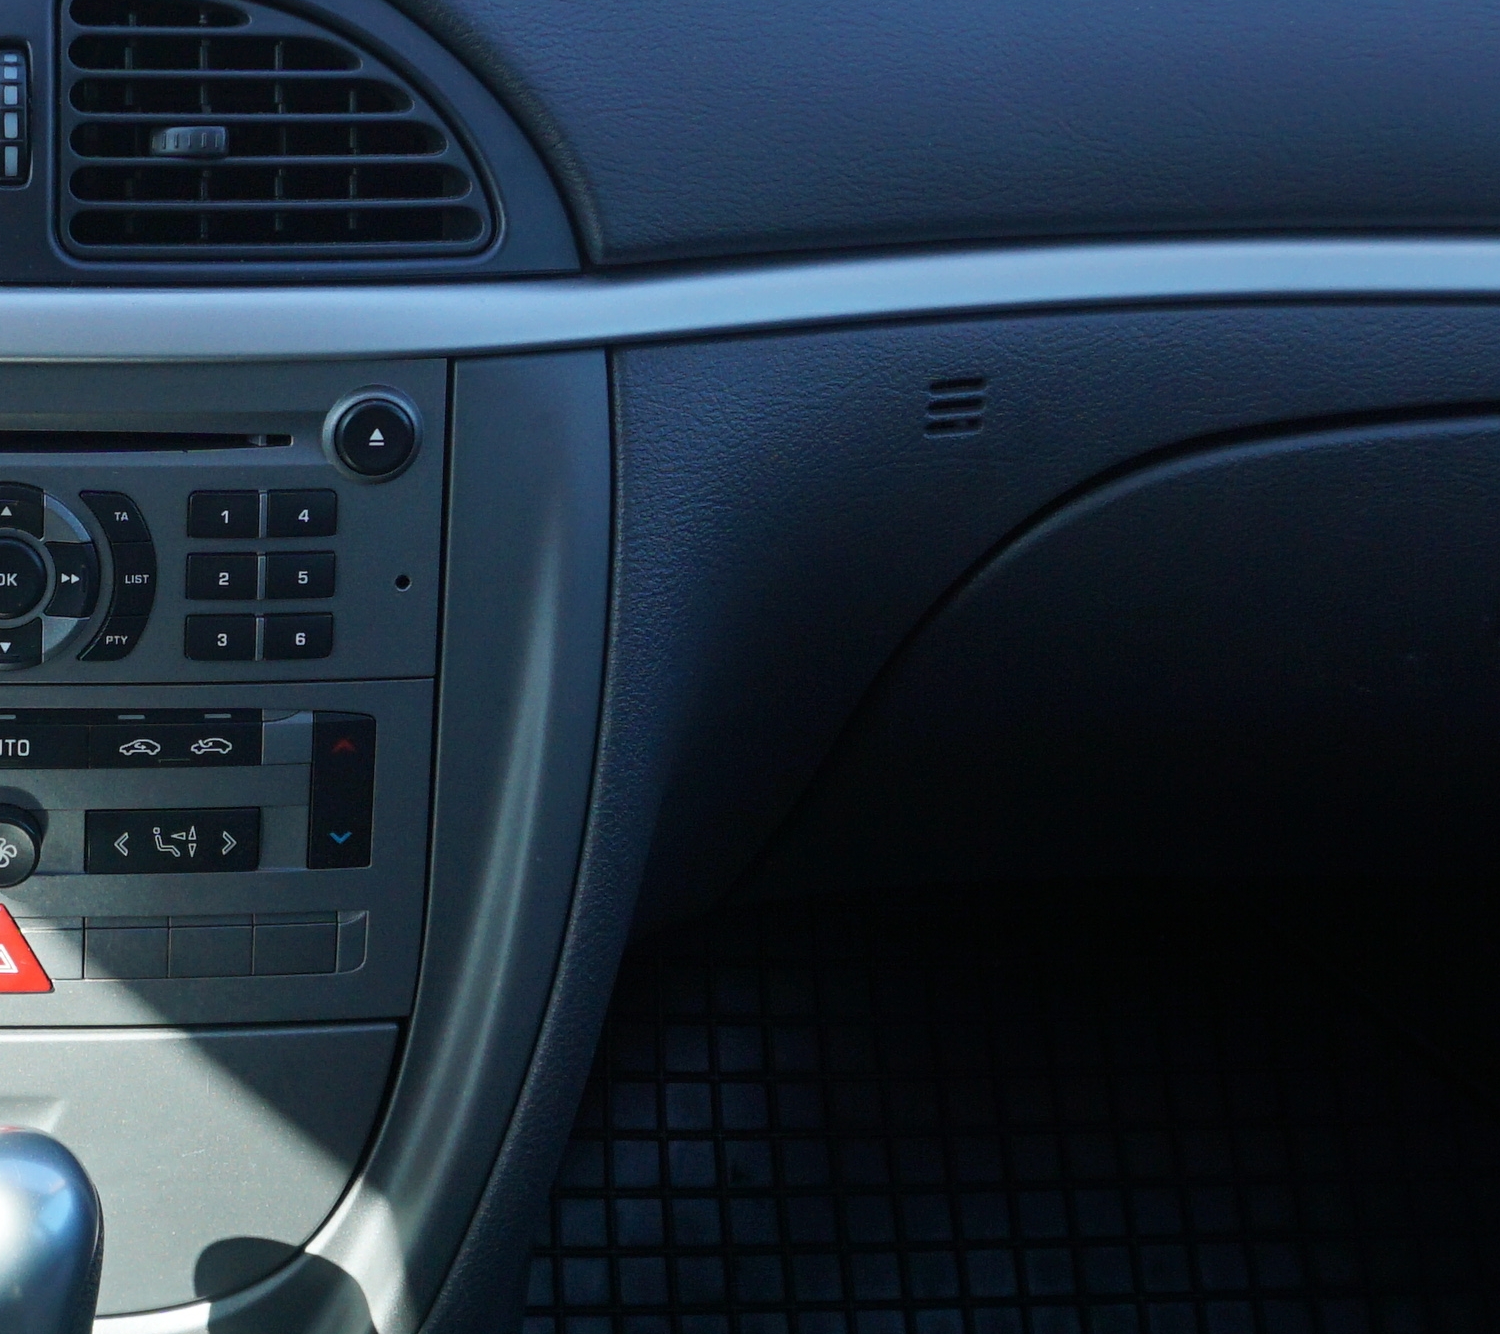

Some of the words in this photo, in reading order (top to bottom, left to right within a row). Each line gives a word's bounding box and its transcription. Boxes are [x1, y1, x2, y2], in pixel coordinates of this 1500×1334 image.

[114, 511, 129, 523] TA
[220, 510, 230, 524] 1
[298, 509, 310, 523] 4
[124, 573, 150, 585] LIST
[218, 572, 229, 586] 2
[297, 571, 308, 585] 5
[105, 634, 129, 646] PTY
[217, 633, 228, 647] 3
[295, 632, 306, 647] 6
